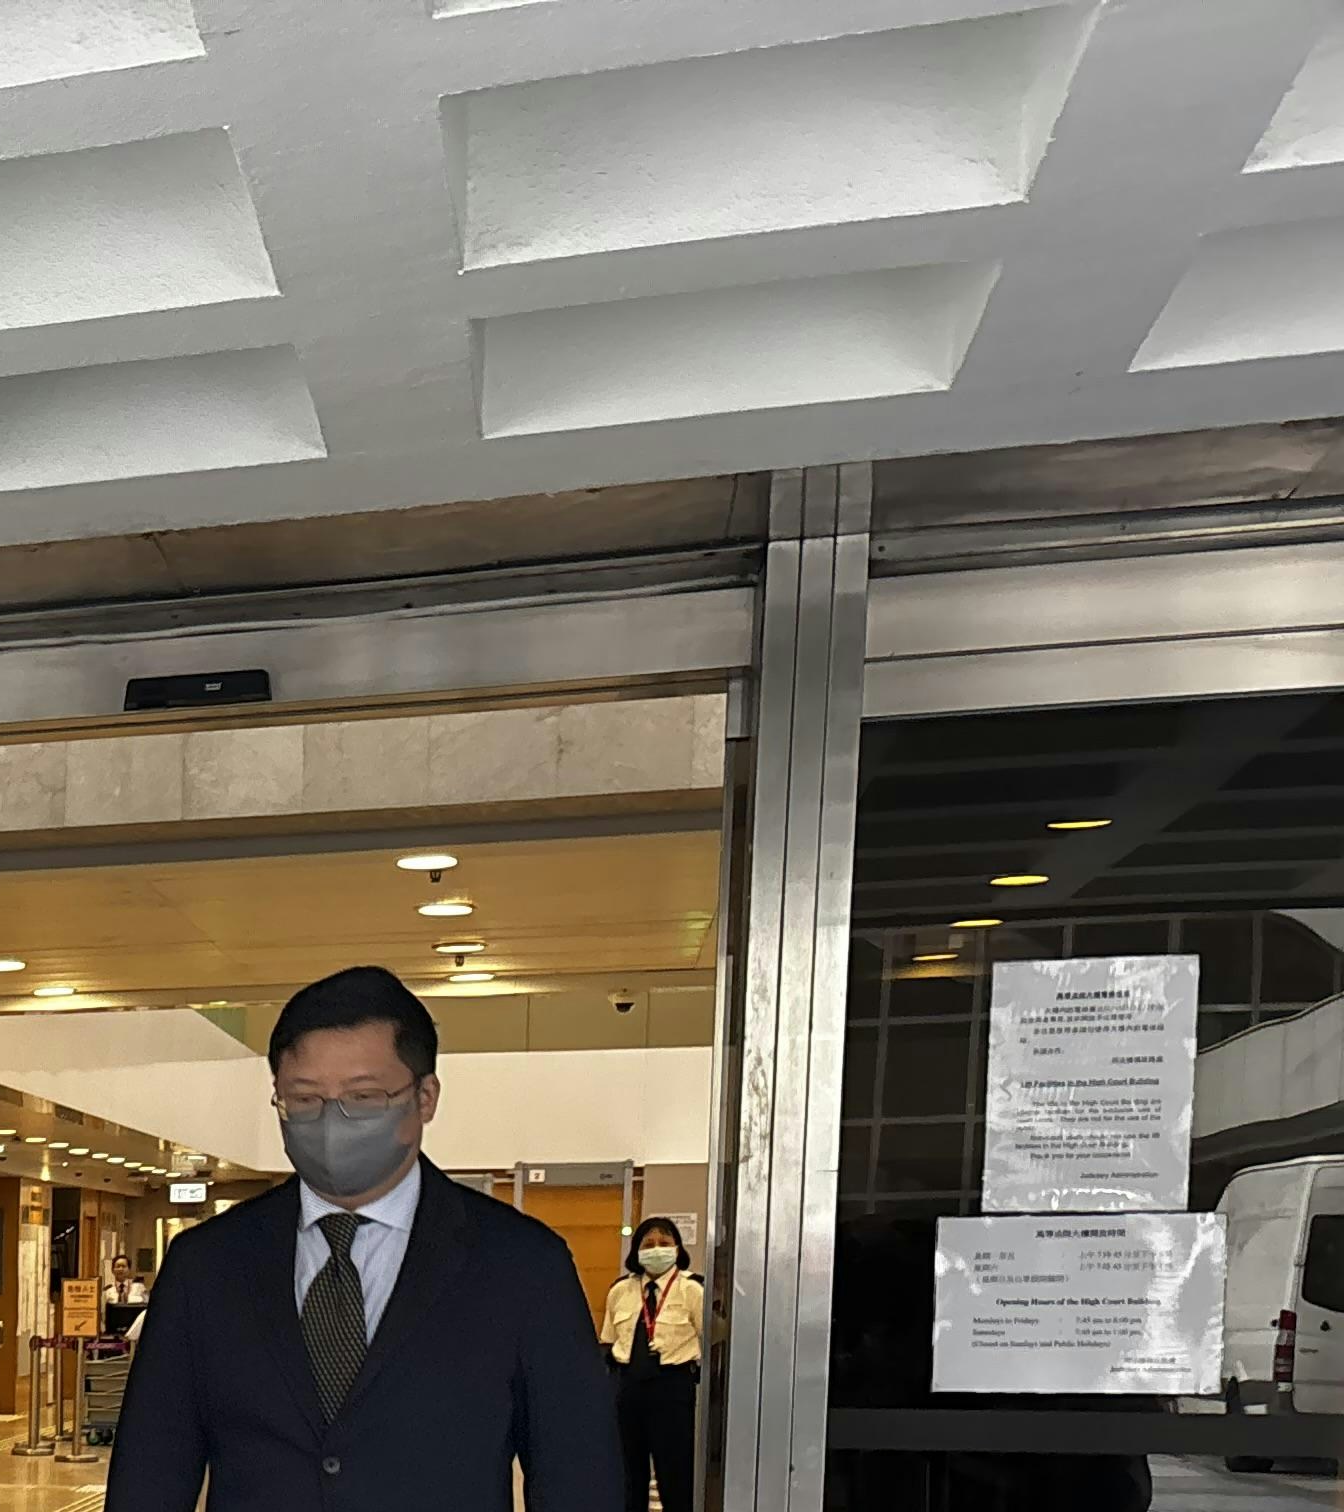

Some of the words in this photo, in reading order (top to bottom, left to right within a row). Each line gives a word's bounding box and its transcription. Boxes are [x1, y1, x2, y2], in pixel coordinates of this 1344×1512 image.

[1129, 1078, 1159, 1086] Building
[995, 1298, 1029, 1307] Opening
[1081, 1298, 1100, 1306] High
